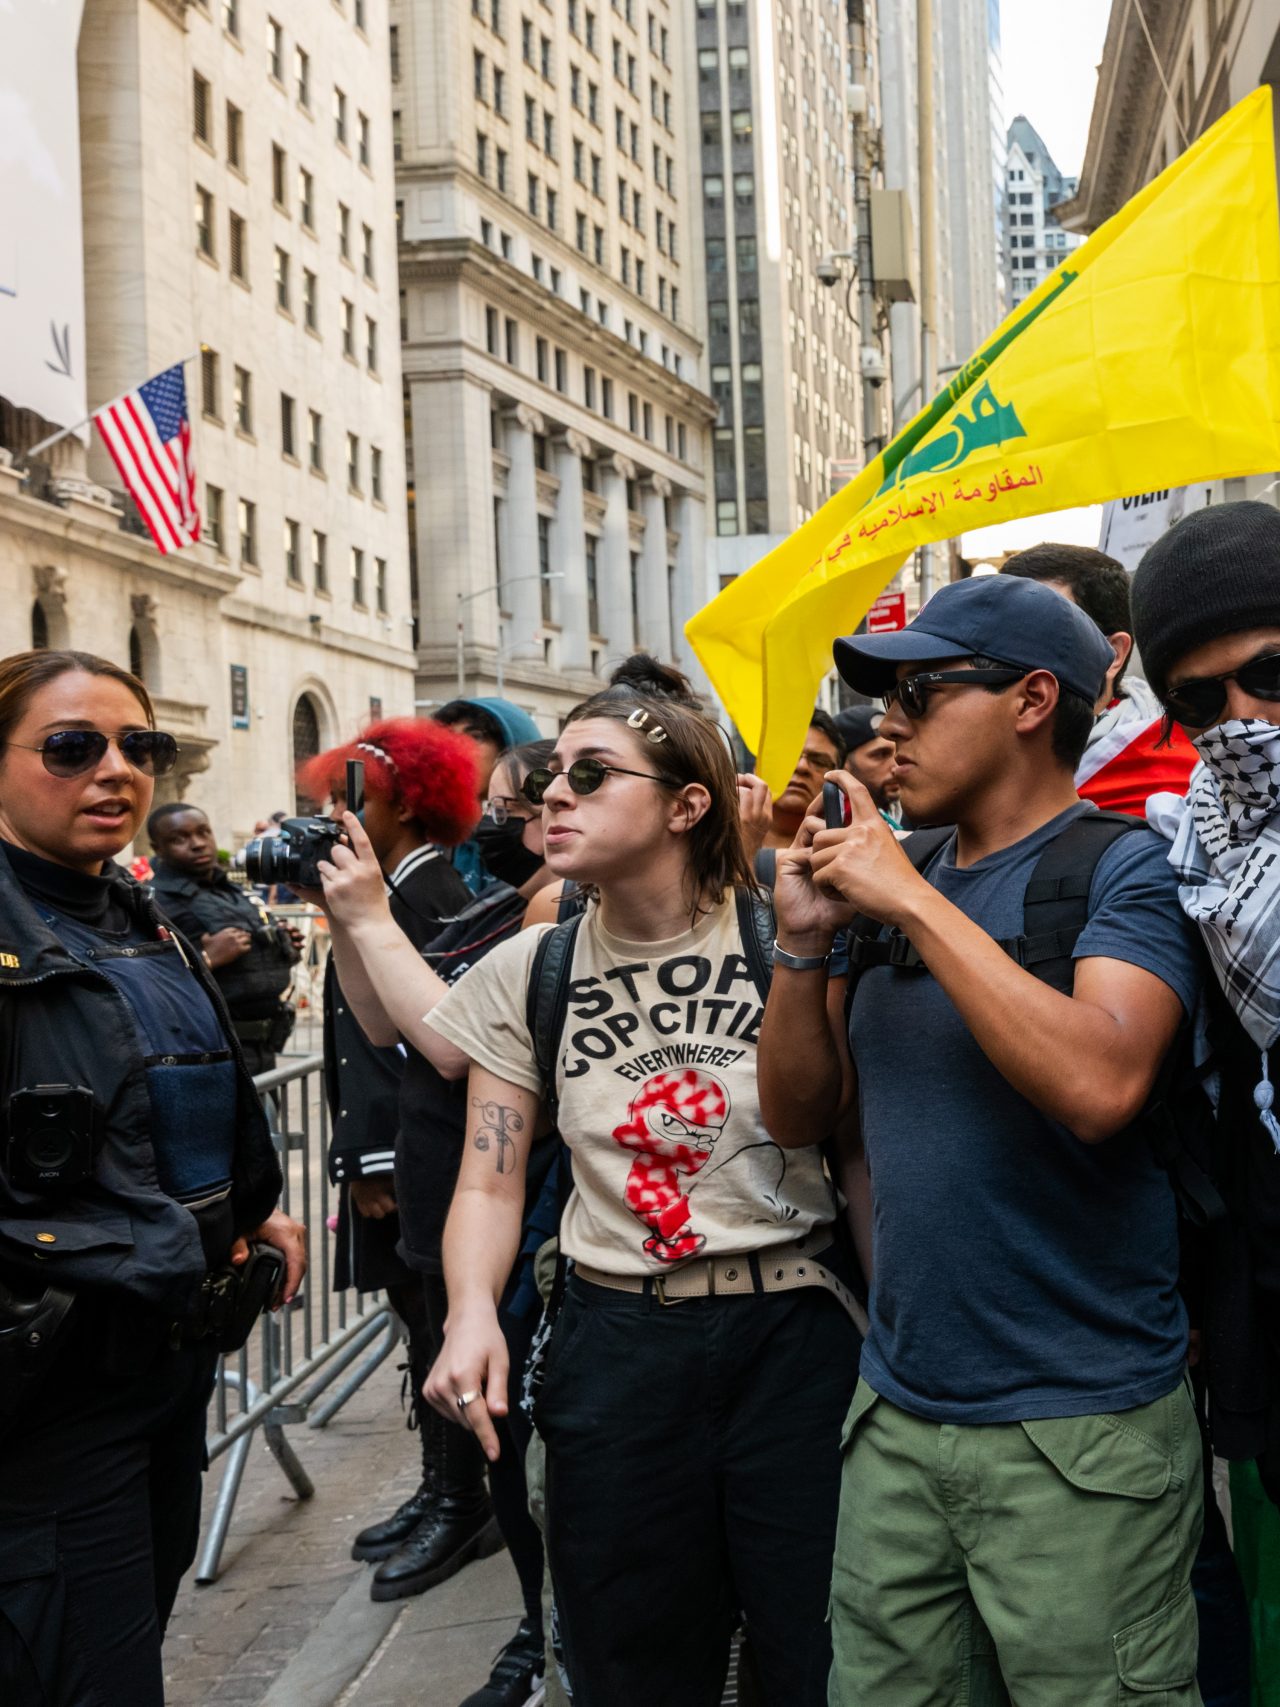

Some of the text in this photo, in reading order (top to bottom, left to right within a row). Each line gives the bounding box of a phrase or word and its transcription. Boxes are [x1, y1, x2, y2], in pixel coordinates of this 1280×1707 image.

[954, 464, 1044, 502] المقاومة
[567, 954, 755, 1020] STOP
[649, 998, 766, 1045] CITIE
[613, 1042, 746, 1082] EVERYWHERE!
